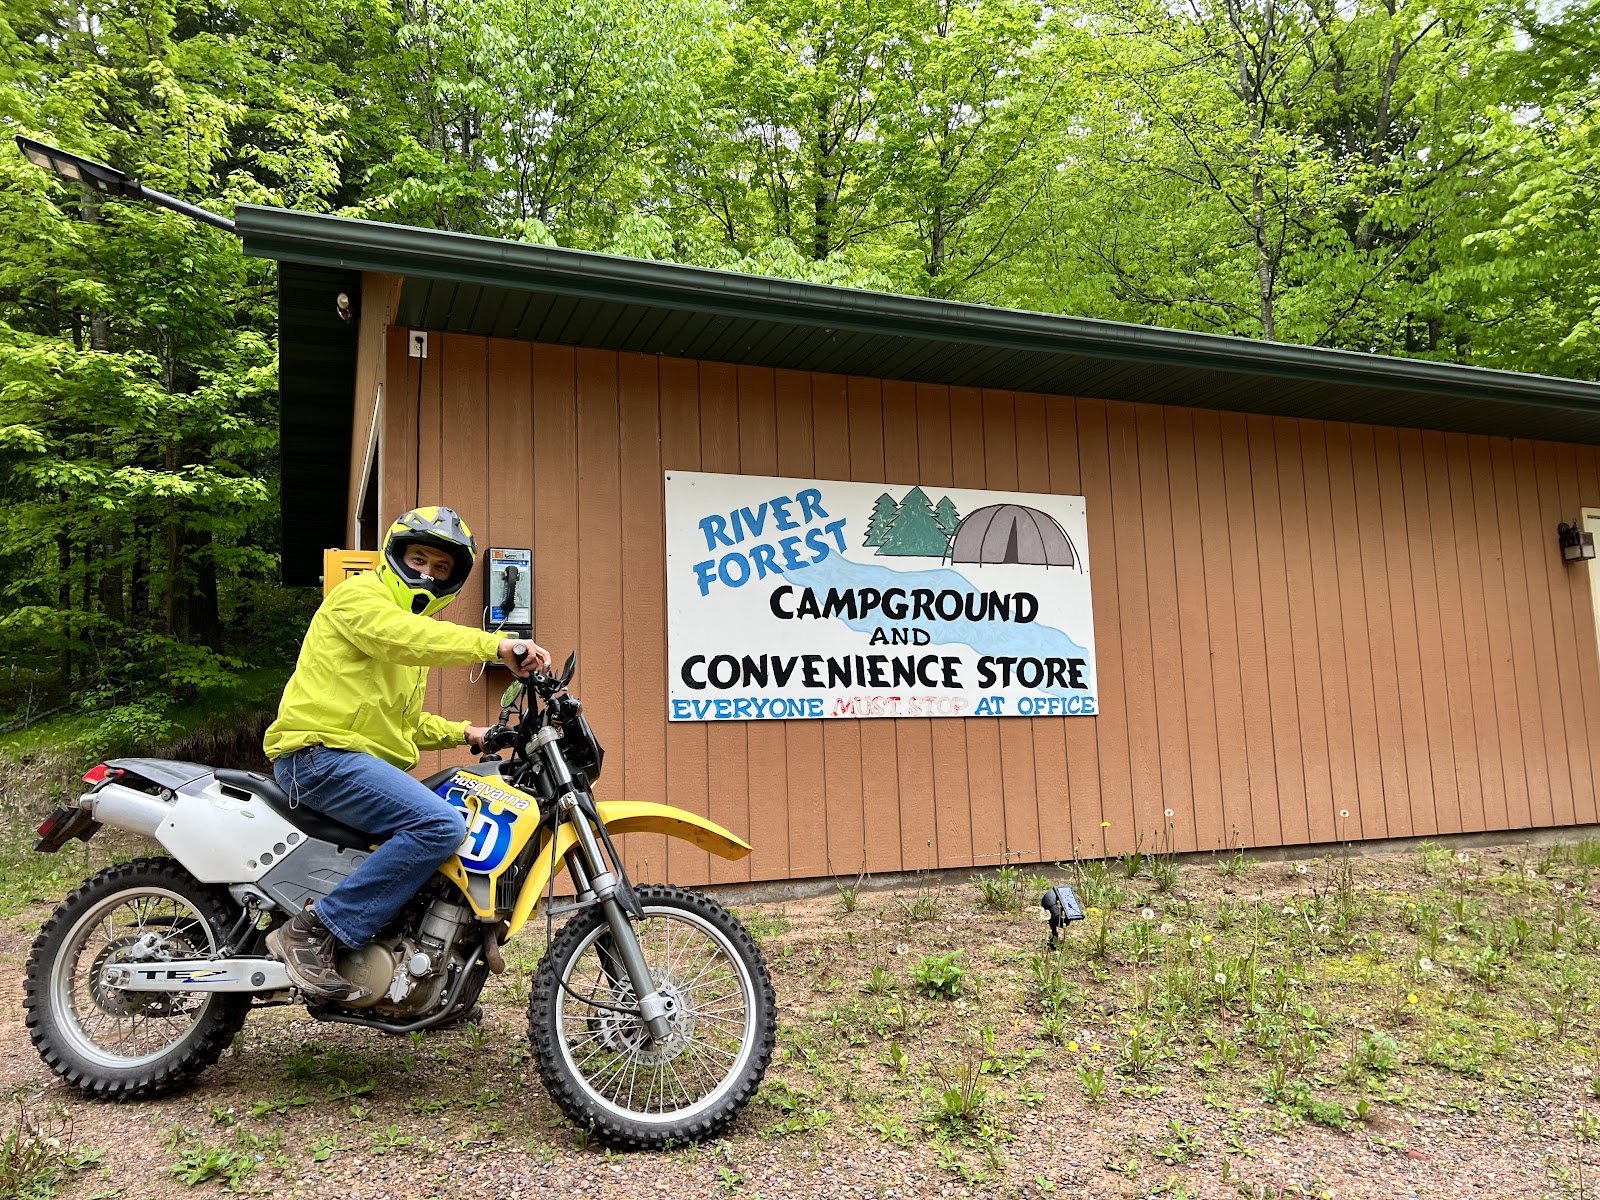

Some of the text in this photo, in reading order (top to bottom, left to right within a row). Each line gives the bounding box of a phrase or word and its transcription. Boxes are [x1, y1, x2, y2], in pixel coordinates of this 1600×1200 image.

[698, 488, 829, 551] RIVER
[693, 519, 847, 597] FOREST
[769, 585, 1039, 624] CAMPGROUND
[869, 627, 931, 646] AND
[681, 654, 1088, 690] CONVENIENCE STORE
[672, 695, 1095, 719] EVERYONE MUST STOP AT OFFICE
[450, 774, 530, 811] Husqvarna
